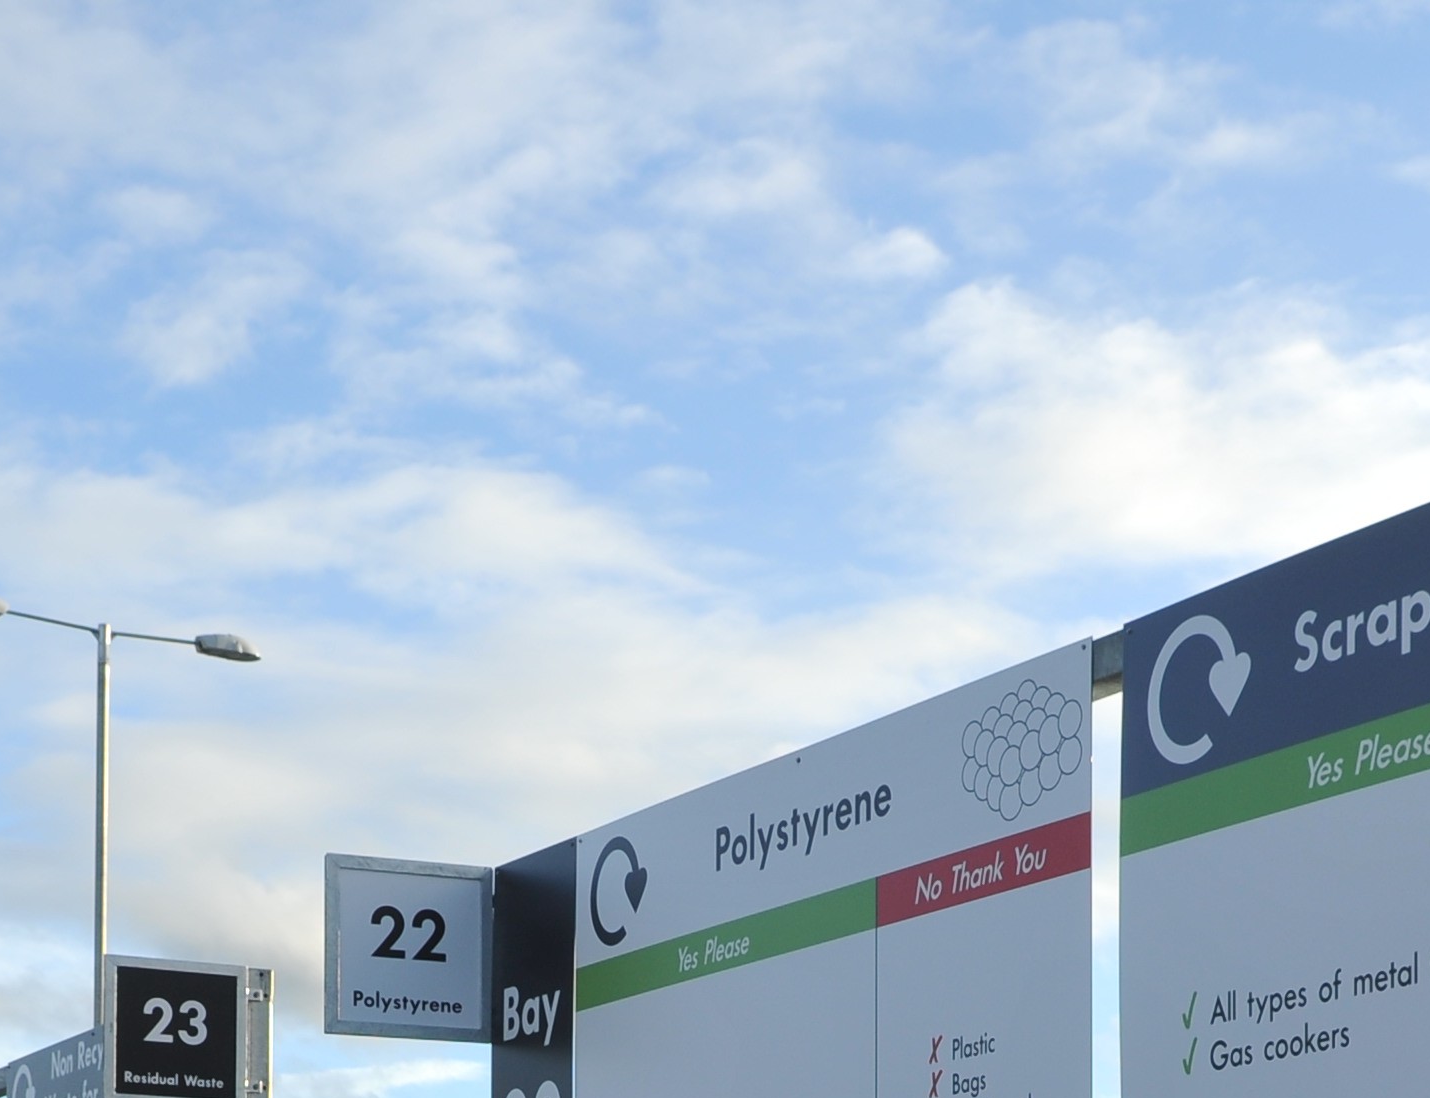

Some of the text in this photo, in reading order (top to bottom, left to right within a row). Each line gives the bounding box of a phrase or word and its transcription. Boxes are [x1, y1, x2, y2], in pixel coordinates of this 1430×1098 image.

[1305, 752, 1344, 790] Yes
[715, 783, 893, 873] Polystyrene
[913, 843, 1048, 905] No Thank You
[370, 905, 447, 963] 22
[677, 934, 751, 972] Yes Please
[352, 989, 463, 1015] Polystyrene
[1209, 989, 1237, 1025] All
[1247, 985, 1308, 1025] types
[1317, 968, 1343, 1004] of
[1352, 951, 1419, 998] metal
[142, 996, 208, 1046] 23
[502, 985, 561, 1047] Bay
[50, 1040, 104, 1080] Non Recy
[951, 1031, 996, 1061] Plastic
[1209, 1022, 1351, 1071] Gas cookers
[123, 1069, 225, 1089] Residual Waste
[951, 1071, 987, 1098] Bags
